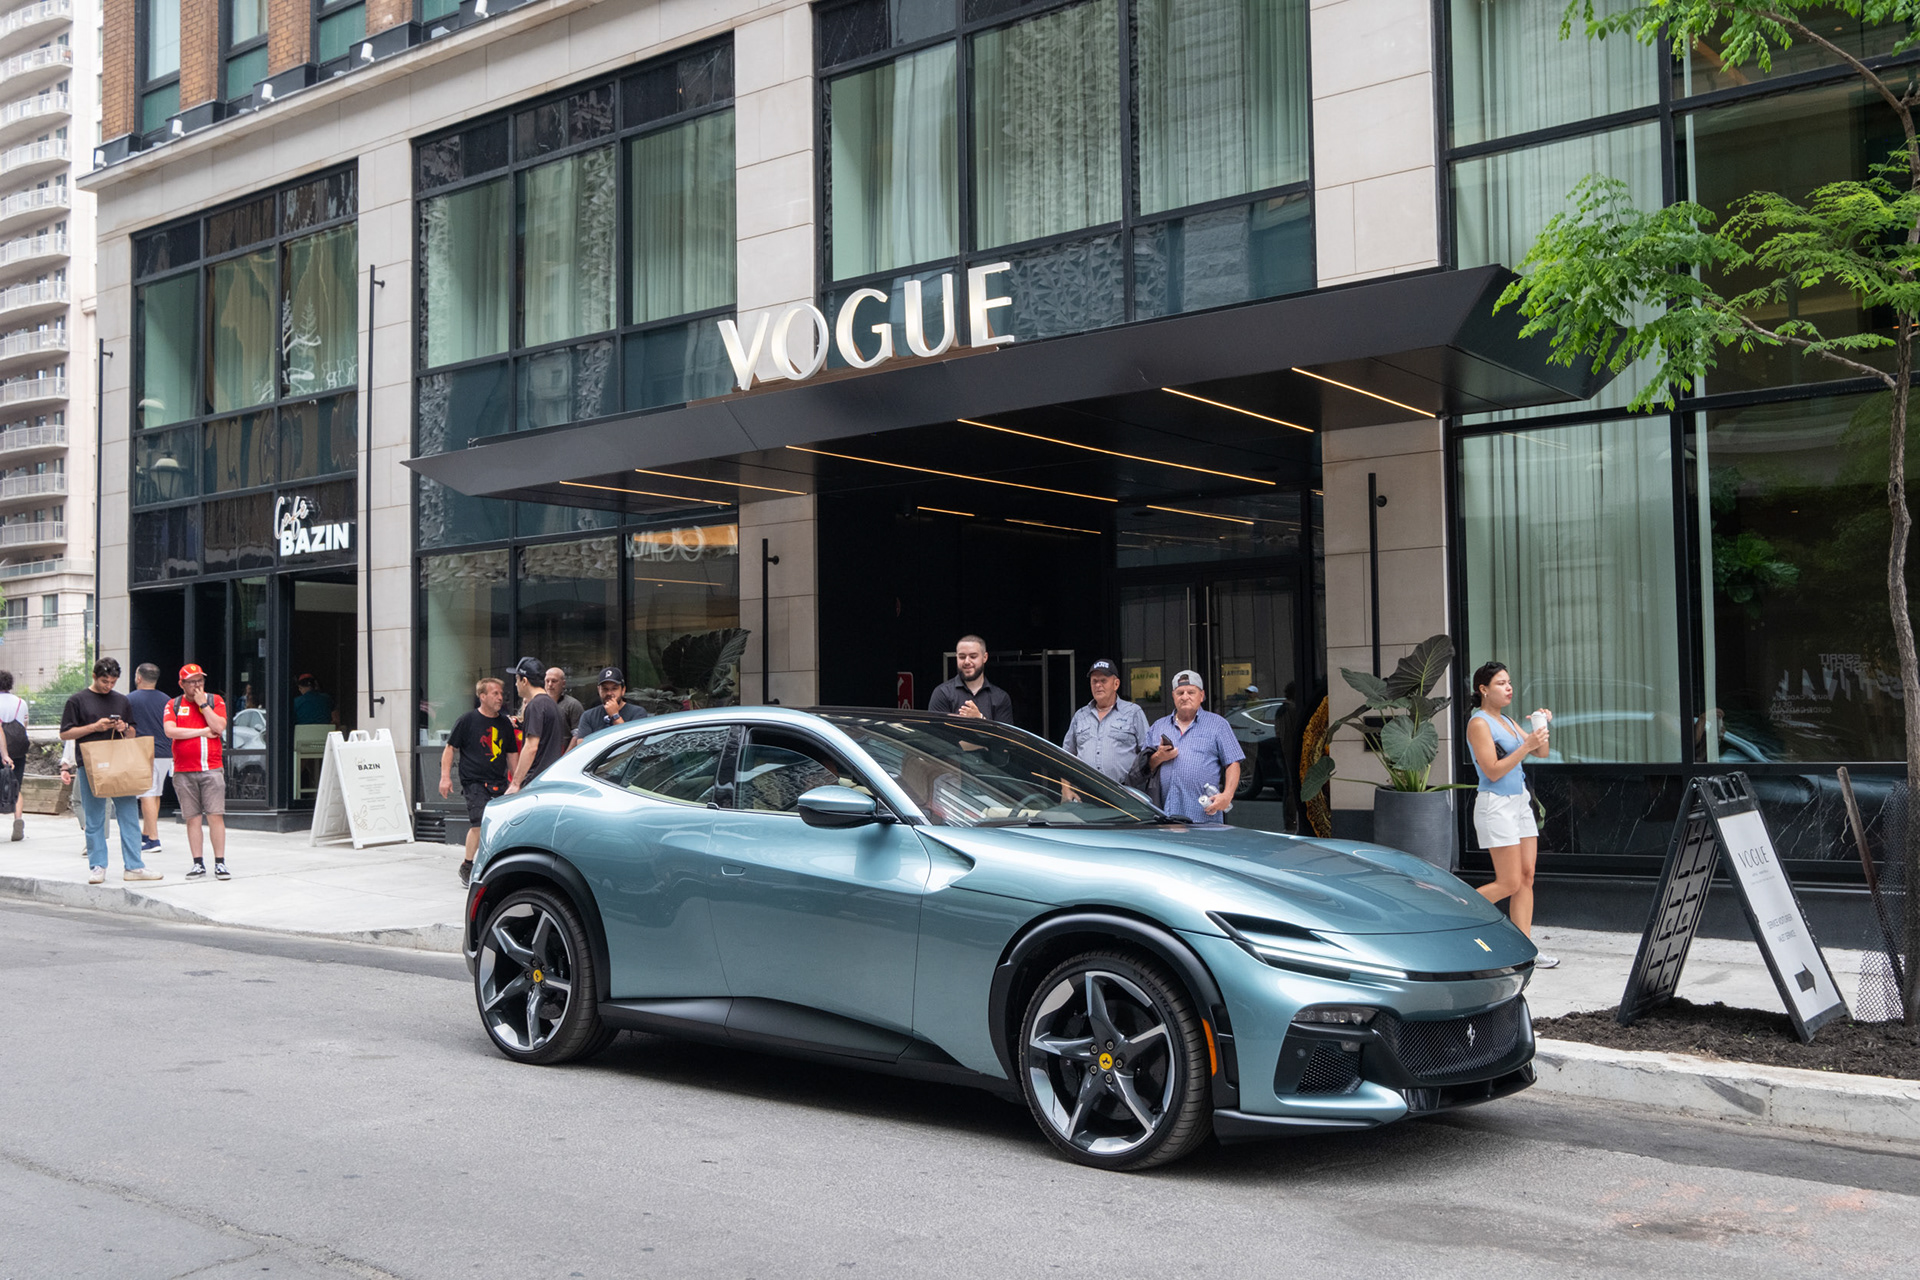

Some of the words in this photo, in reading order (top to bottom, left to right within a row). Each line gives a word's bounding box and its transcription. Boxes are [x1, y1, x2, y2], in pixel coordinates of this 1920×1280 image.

[717, 261, 1014, 391] VOGUE
[280, 522, 349, 556] BAZIN
[357, 763, 380, 771] BAZIN
[1738, 846, 1769, 868] VOGUE
